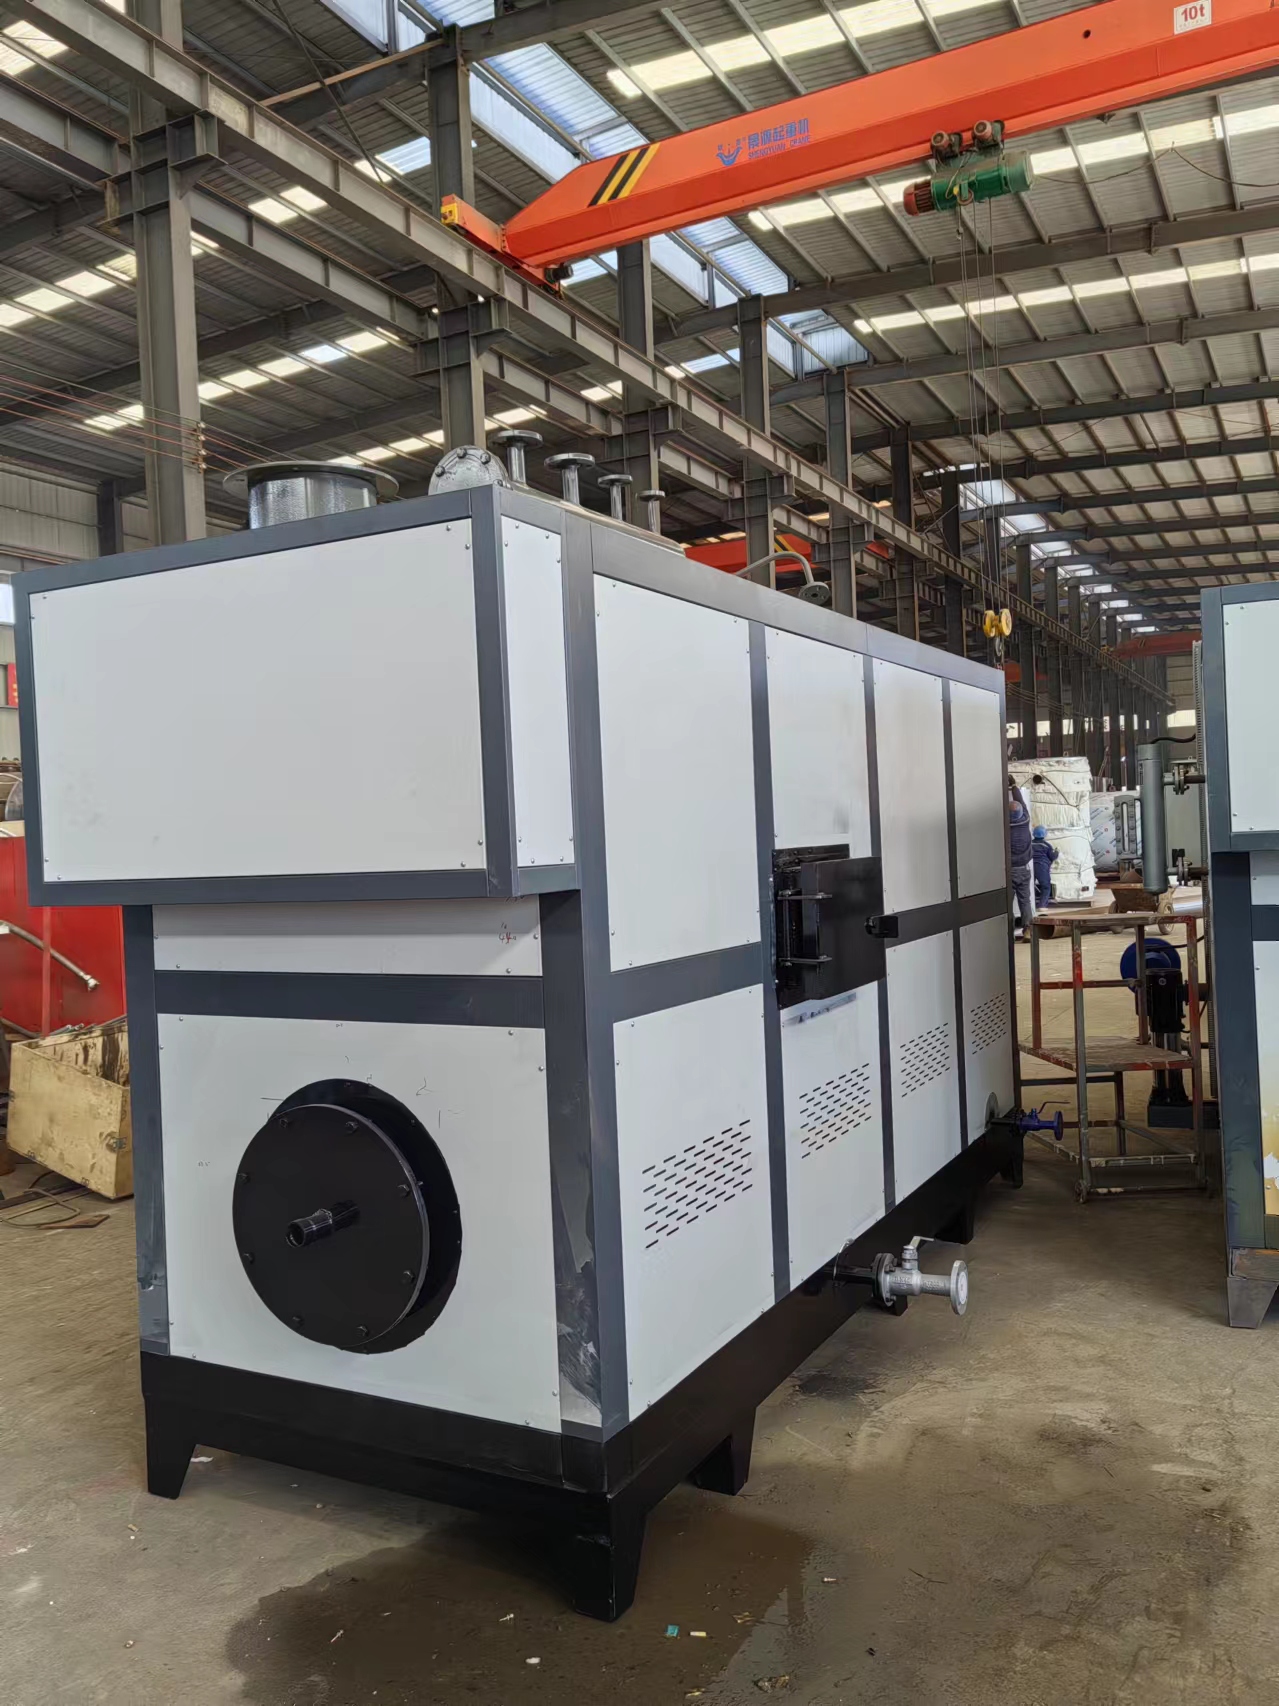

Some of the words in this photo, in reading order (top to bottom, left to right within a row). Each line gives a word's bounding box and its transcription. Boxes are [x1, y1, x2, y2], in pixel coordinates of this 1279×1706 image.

[1181, 4, 1205, 22] 10t
[748, 143, 786, 159] SHENGYUAN
[790, 135, 810, 148] CRANE
